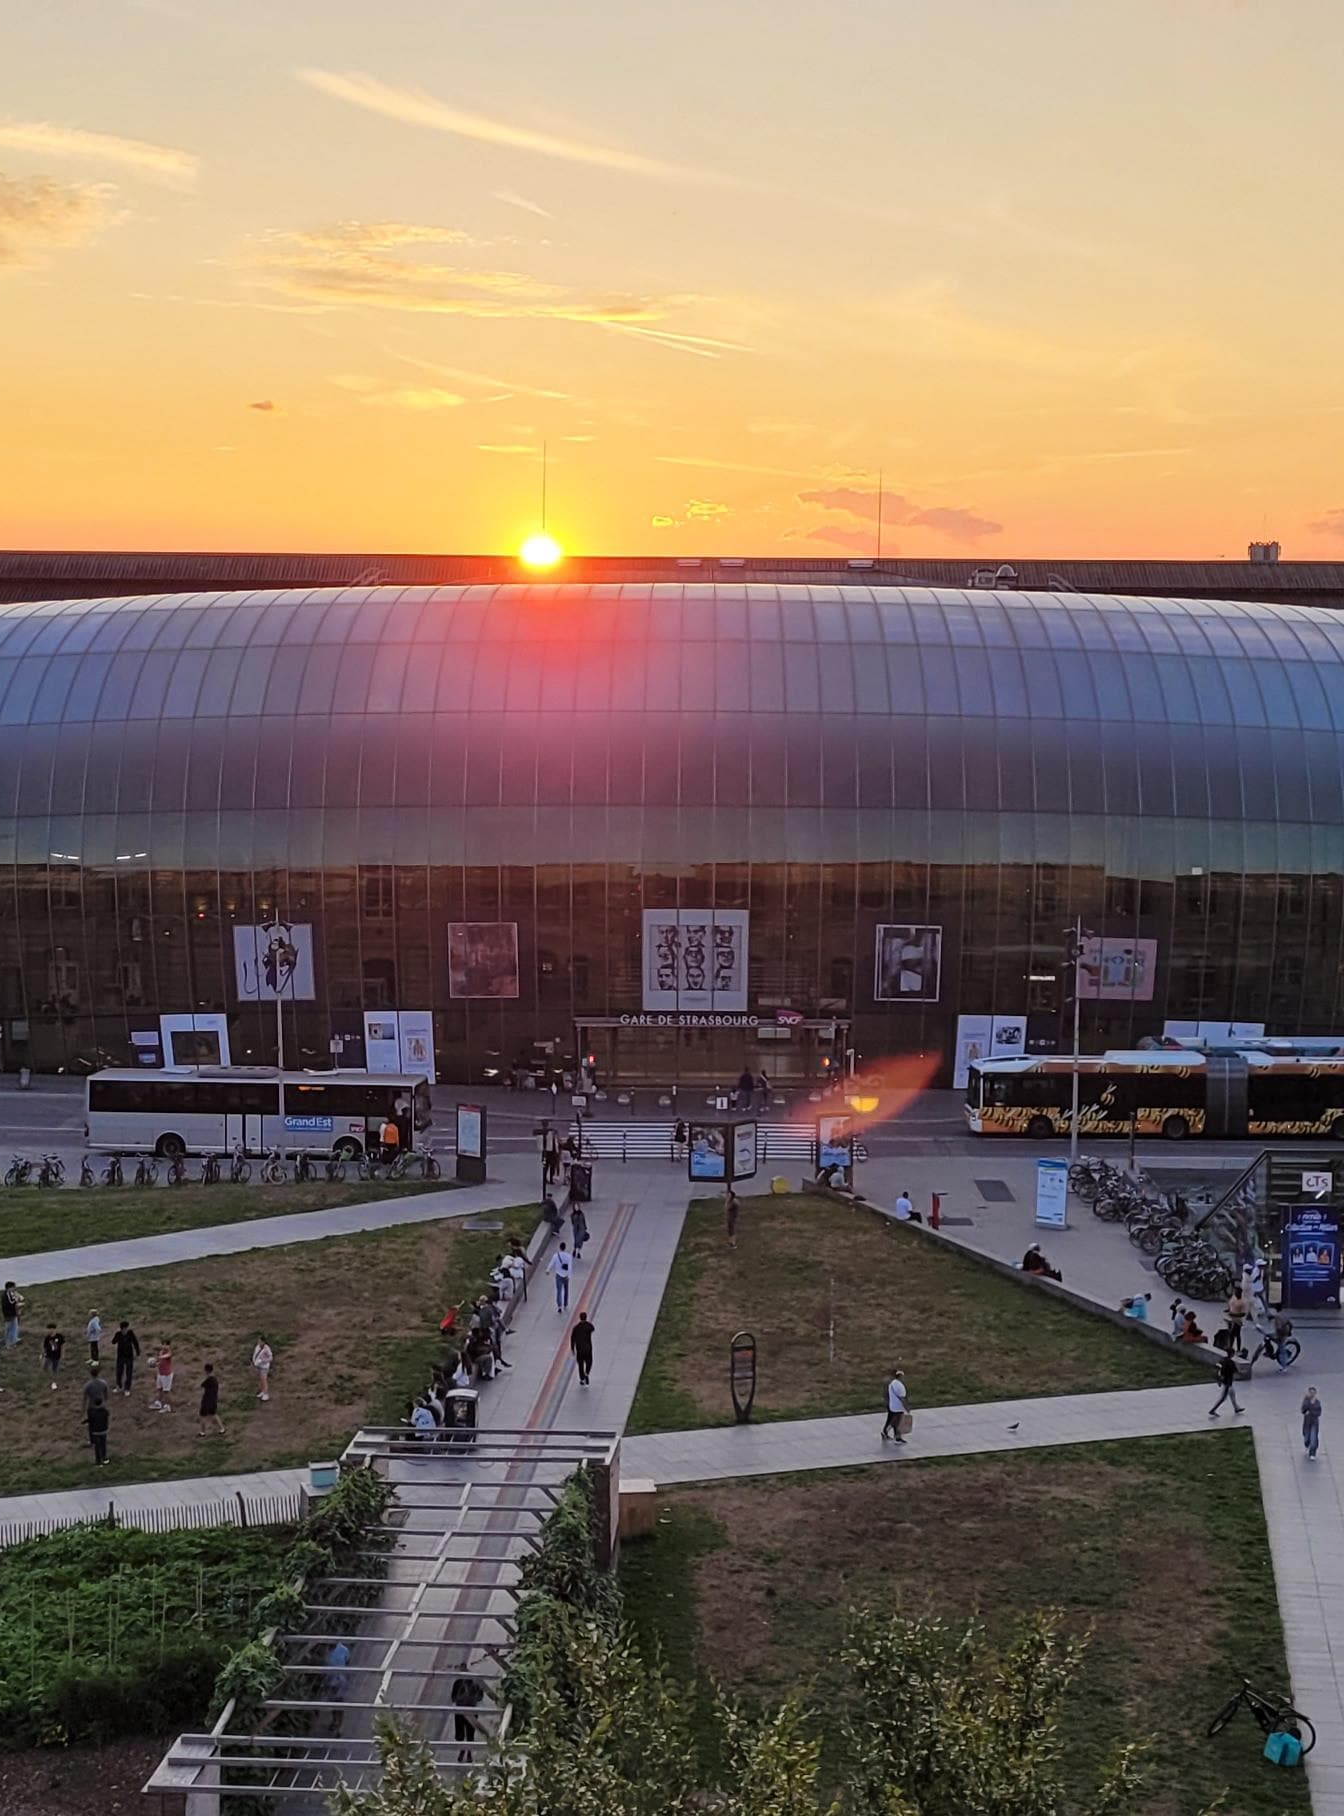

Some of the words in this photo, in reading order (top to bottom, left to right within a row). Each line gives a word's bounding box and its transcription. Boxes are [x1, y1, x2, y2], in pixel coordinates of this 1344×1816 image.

[620, 1014, 653, 1026] GARE
[658, 1014, 674, 1026] DE
[678, 1015, 758, 1026] STRASBOURG
[776, 1016, 803, 1025] SNCF
[1305, 1175, 1329, 1188] CTS
